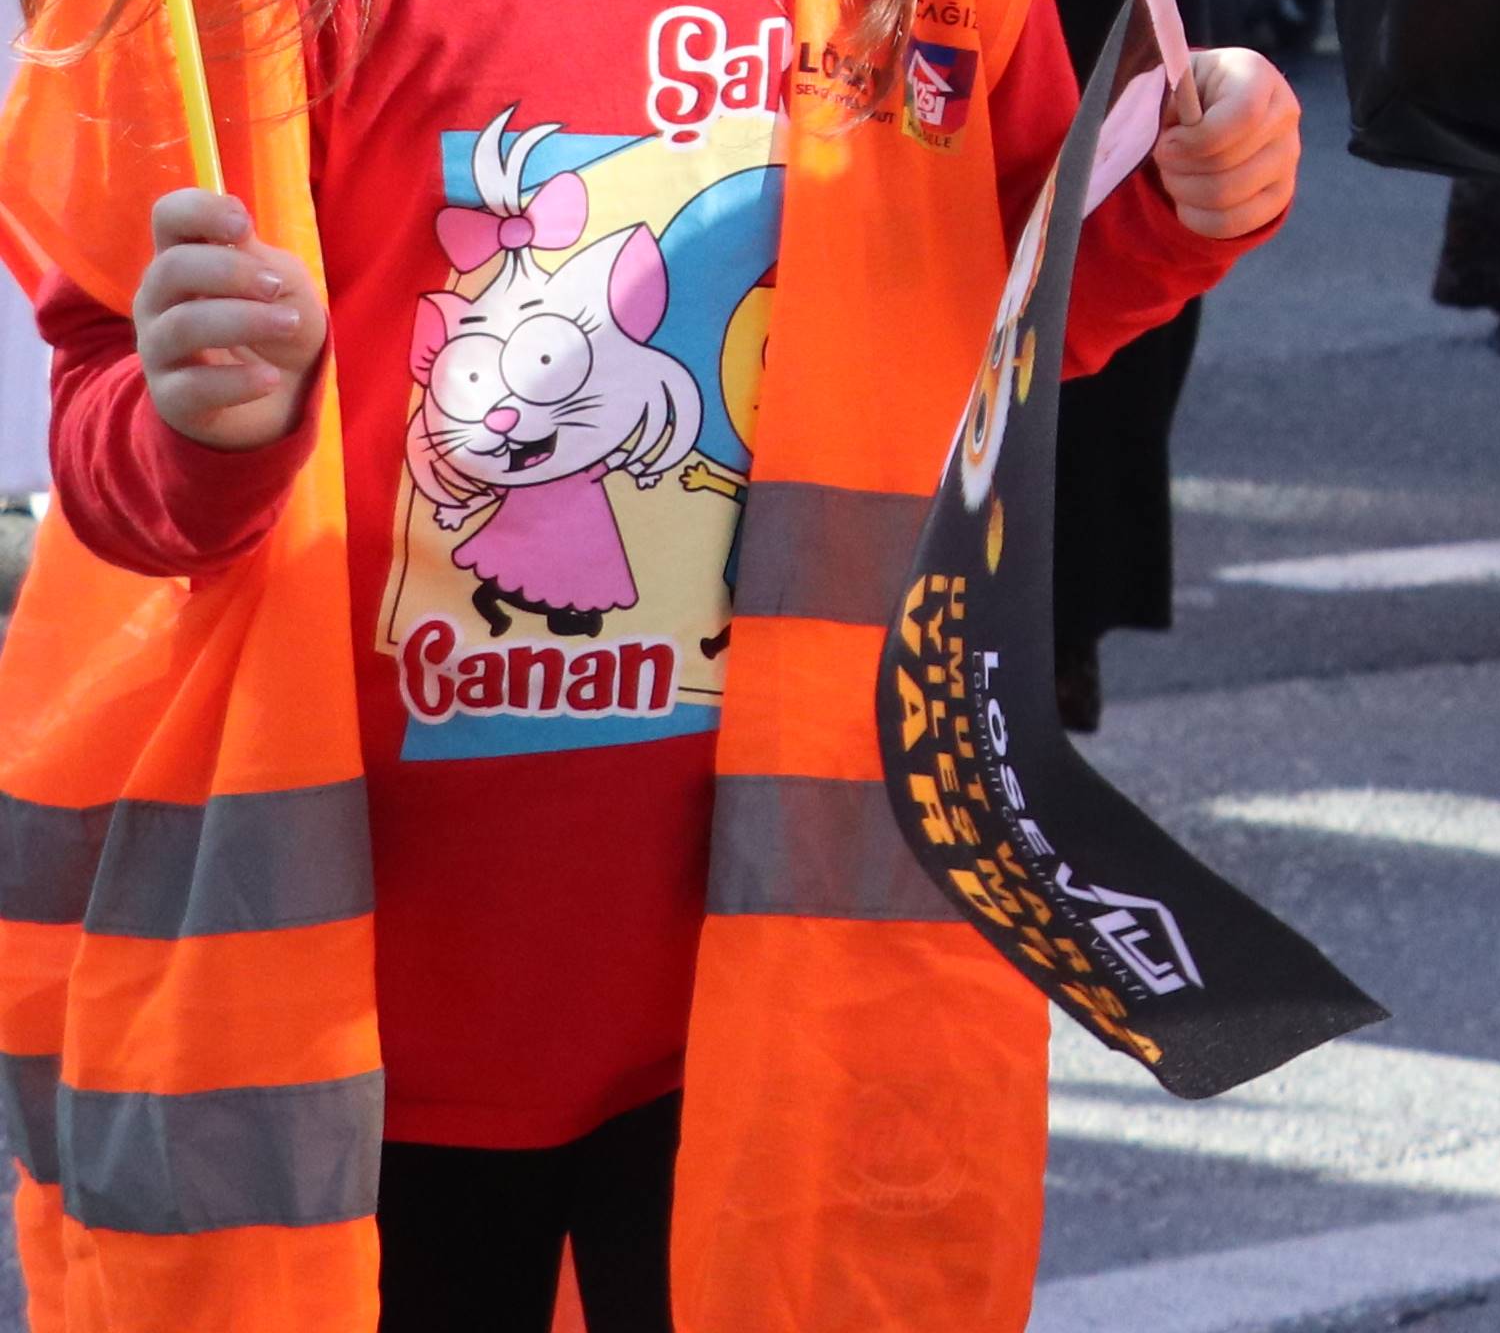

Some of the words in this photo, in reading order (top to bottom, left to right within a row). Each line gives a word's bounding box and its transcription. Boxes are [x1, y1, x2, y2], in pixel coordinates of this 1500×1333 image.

[401, 617, 676, 719] Canan
[949, 575, 992, 812] UMUT
[982, 651, 1100, 903] LÖSEV
